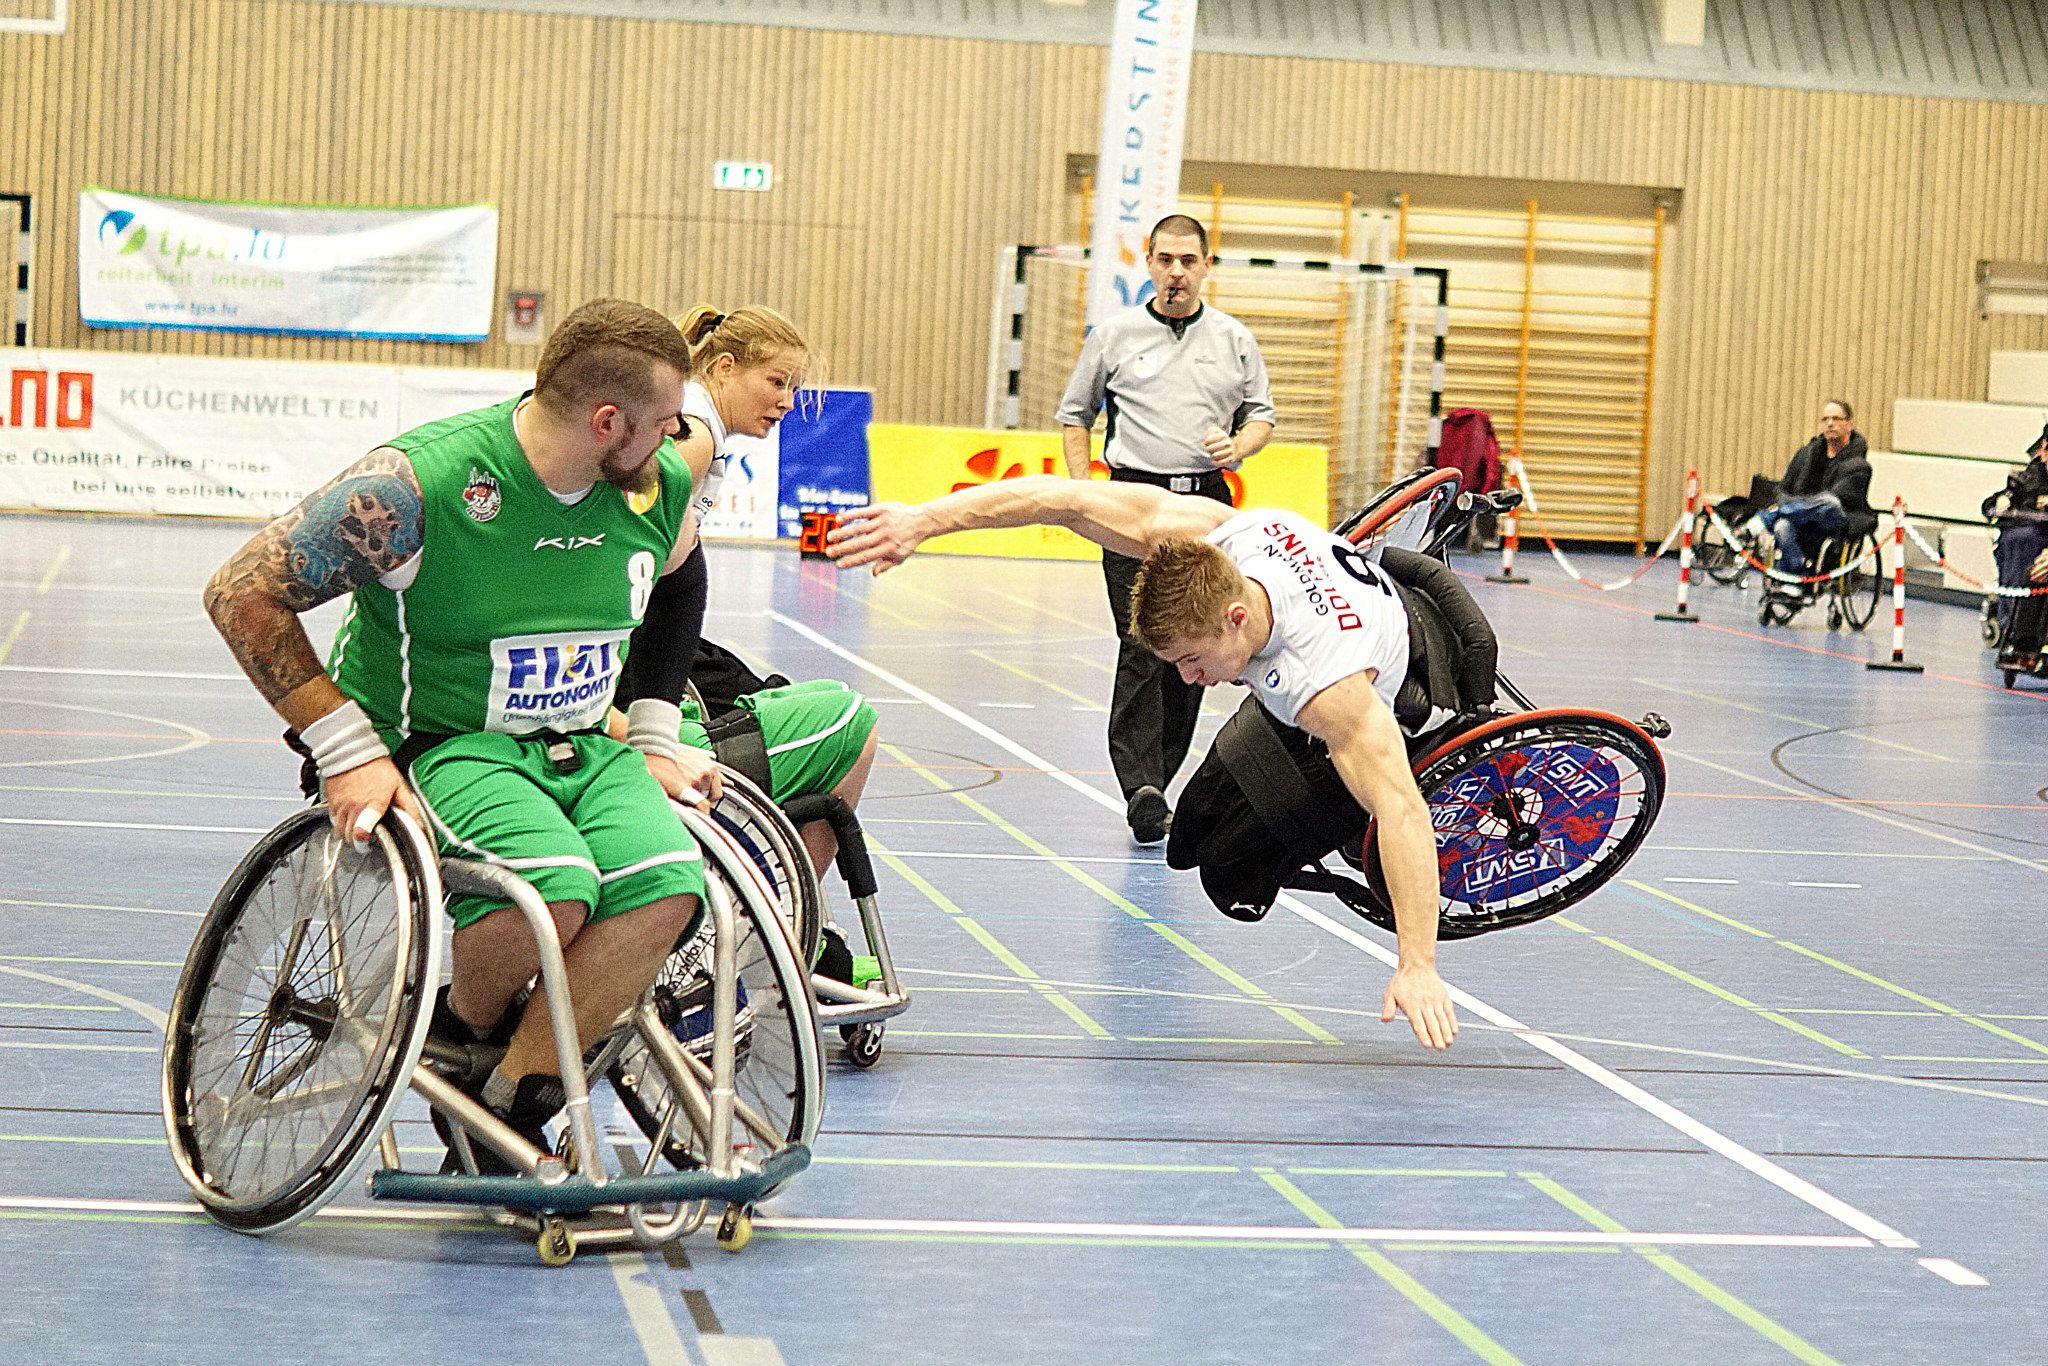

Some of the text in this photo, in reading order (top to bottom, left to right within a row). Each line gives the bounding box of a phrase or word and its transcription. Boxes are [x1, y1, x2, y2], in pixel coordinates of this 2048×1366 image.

[119, 384, 379, 420] KÜCHENWELTEN
[628, 551, 655, 620] 8
[505, 673, 613, 710] AUTONOMY
